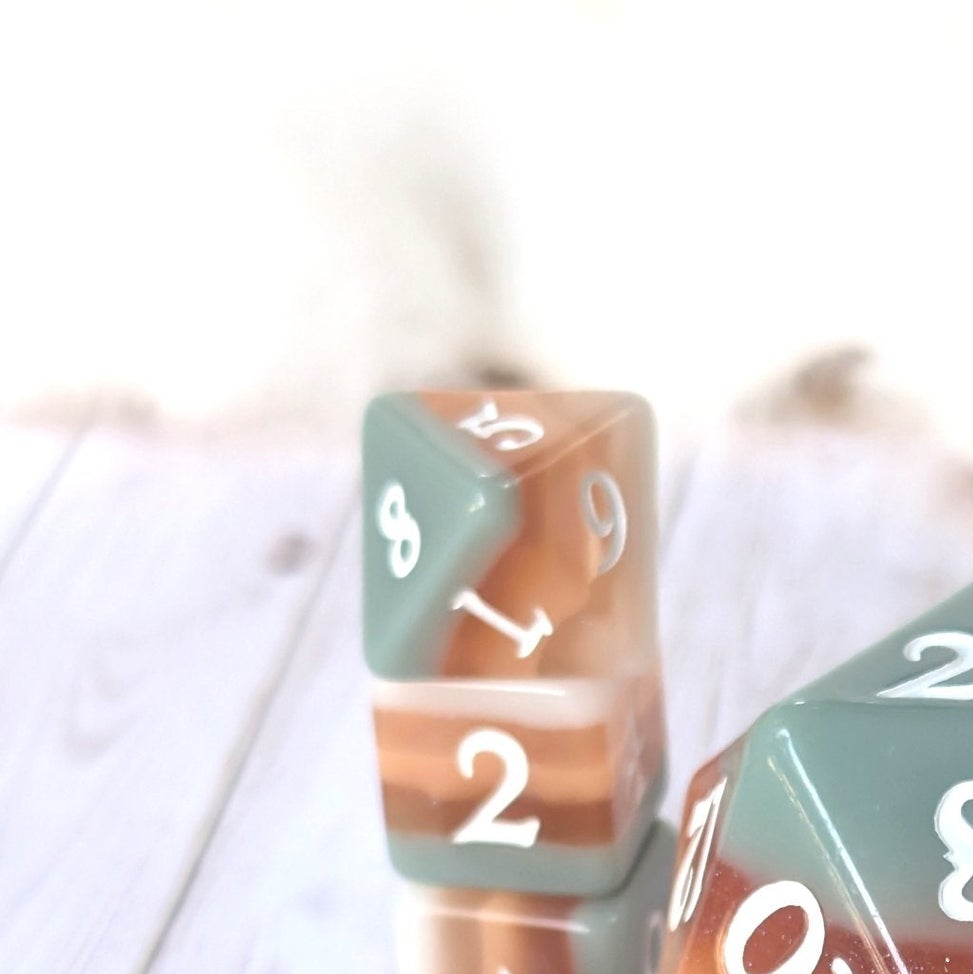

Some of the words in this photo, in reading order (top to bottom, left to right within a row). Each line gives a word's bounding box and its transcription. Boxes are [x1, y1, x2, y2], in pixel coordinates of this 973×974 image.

[376, 476, 421, 578] 8
[451, 588, 554, 659] 1
[452, 726, 541, 847] 2
